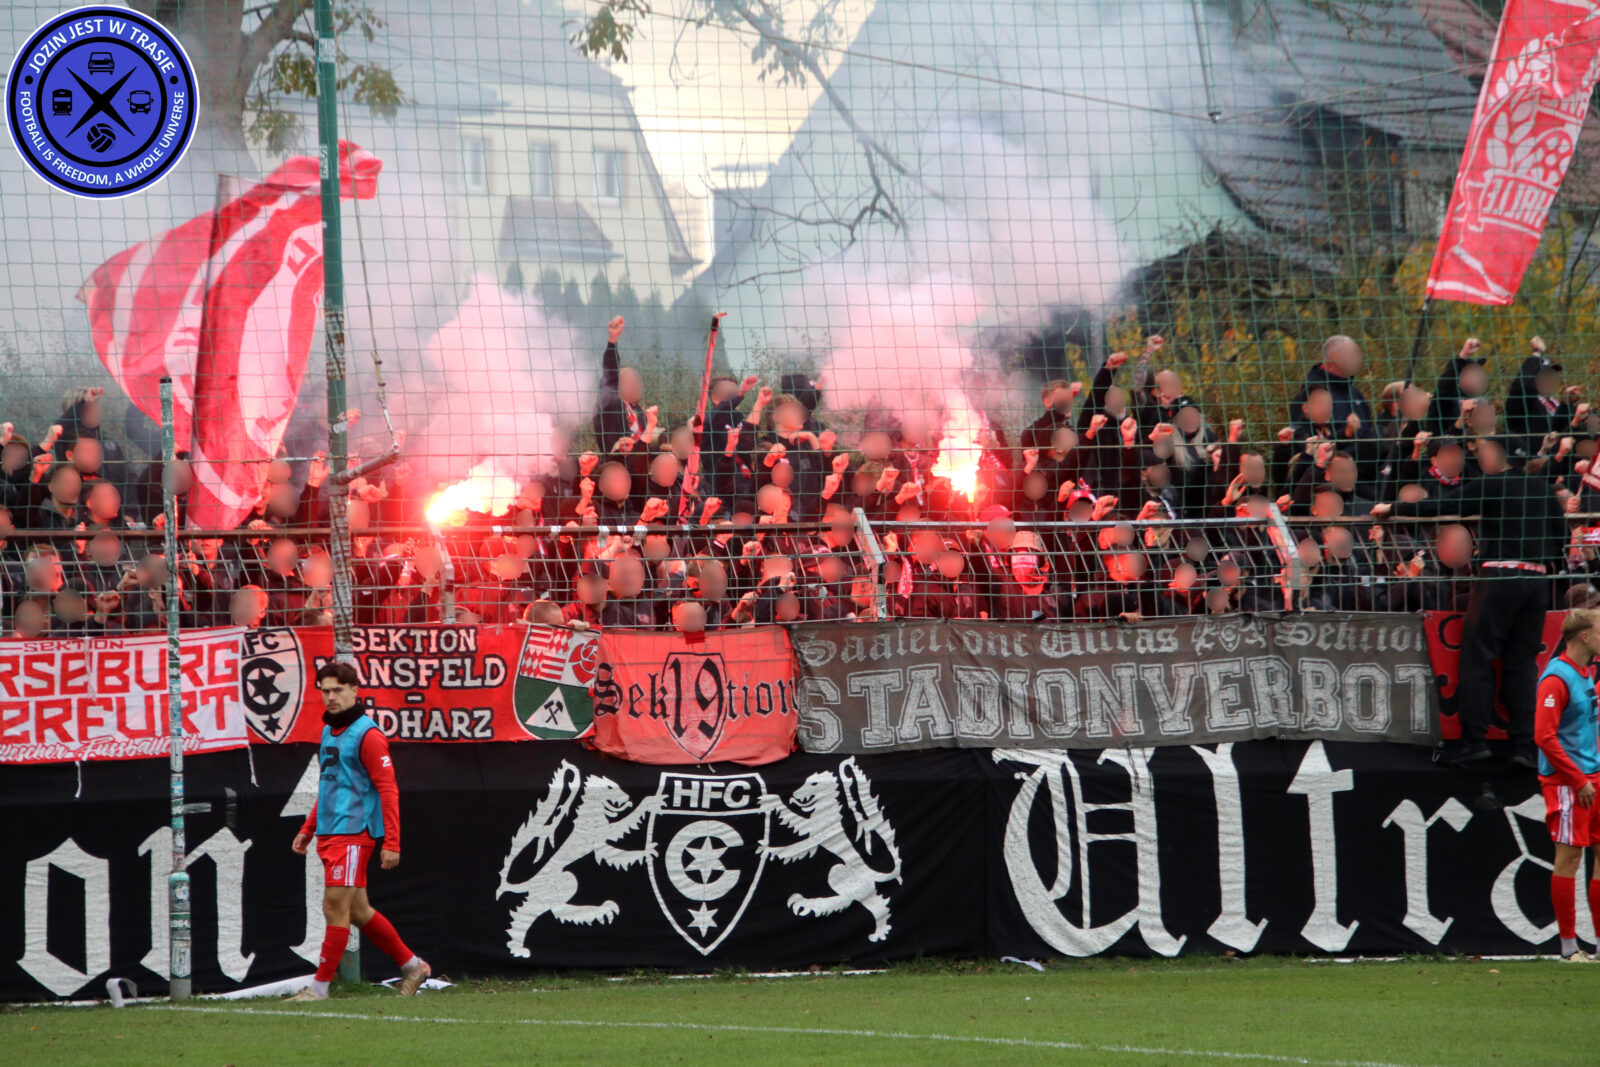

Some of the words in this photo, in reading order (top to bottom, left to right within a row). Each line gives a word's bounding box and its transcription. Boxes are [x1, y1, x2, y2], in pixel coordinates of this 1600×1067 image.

[24, 639, 124, 652] SEKTION
[242, 633, 280, 656] FC
[351, 627, 478, 653] SEKTION
[798, 655, 1435, 754] STADIONVERBOT
[673, 780, 750, 809] HFC
